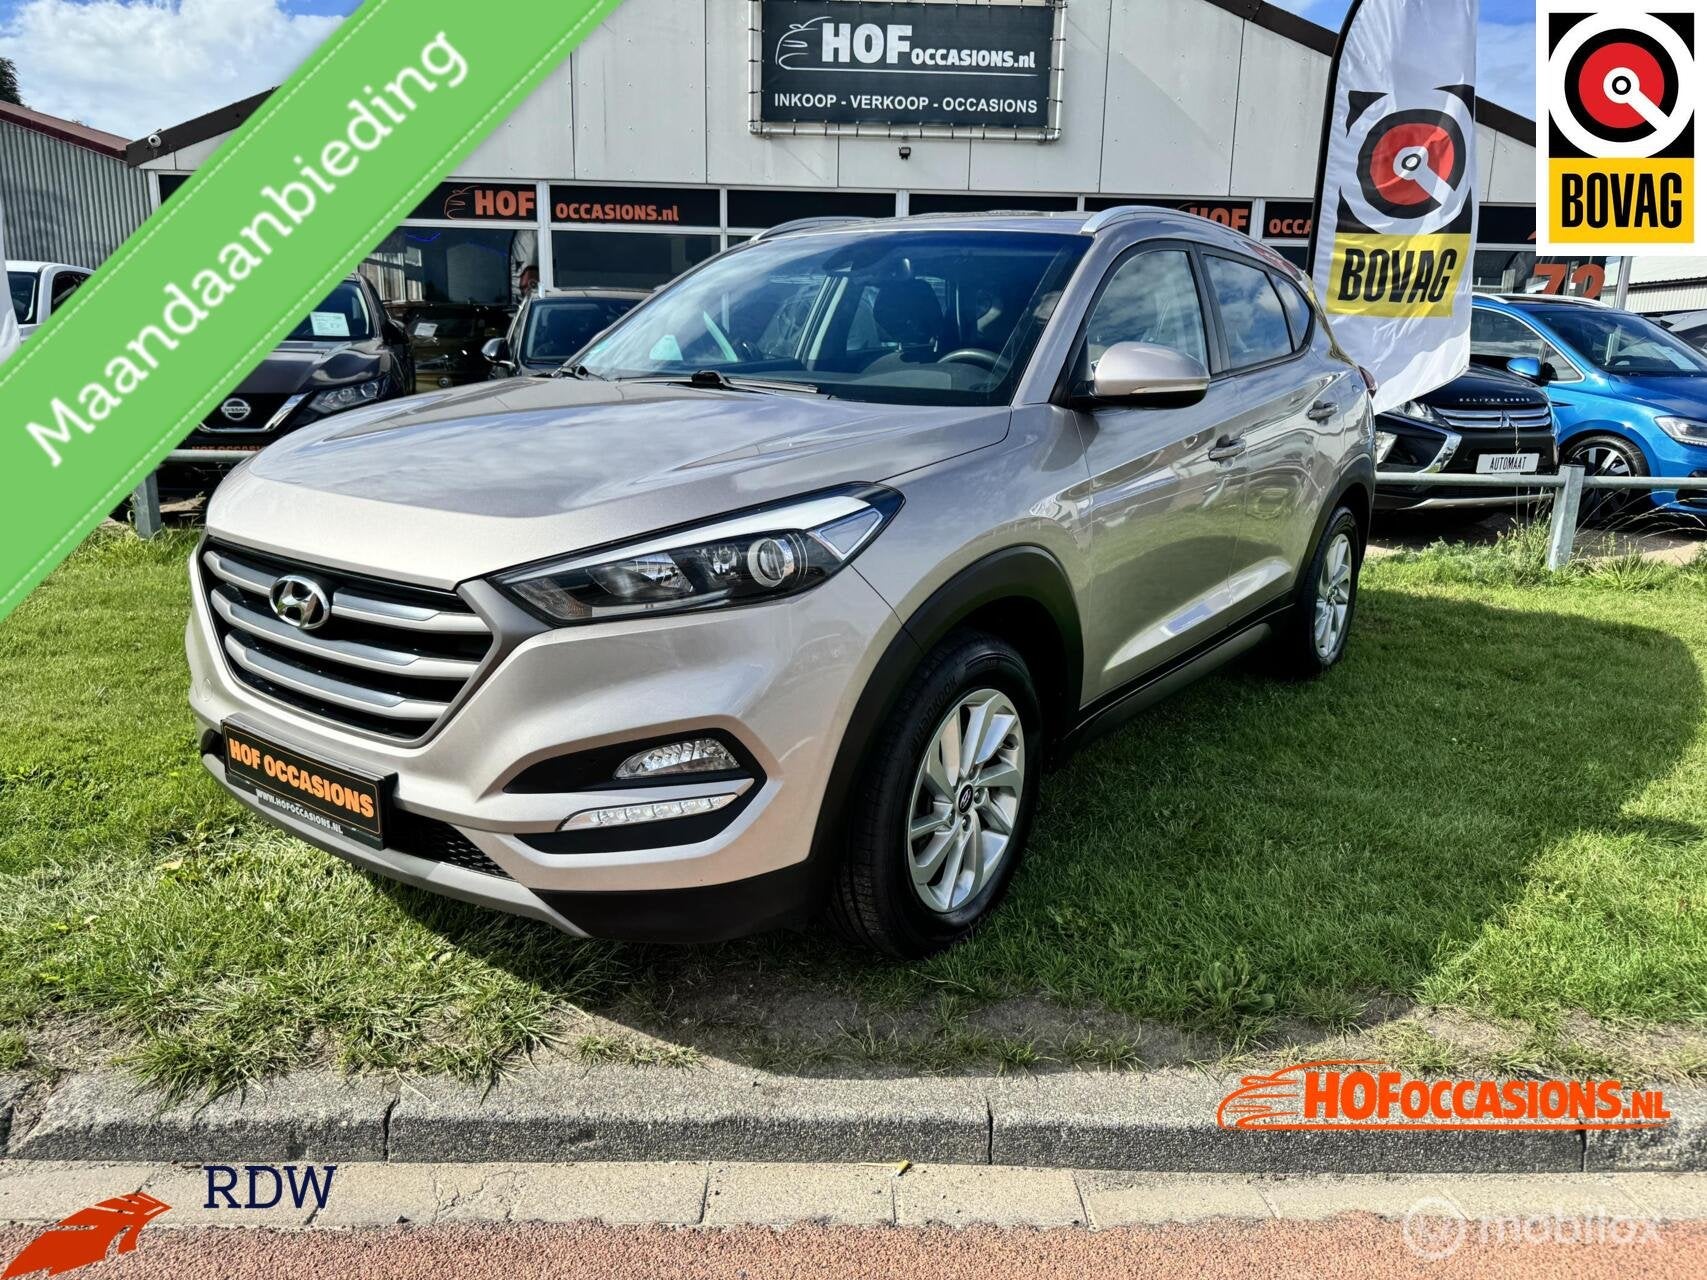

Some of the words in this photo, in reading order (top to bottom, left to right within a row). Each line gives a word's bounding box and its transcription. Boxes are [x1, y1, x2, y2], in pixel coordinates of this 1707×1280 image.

[774, 93, 837, 109] INKOOP
[850, 95, 929, 111] VERKOOP
[942, 97, 1038, 113] OCCASIONS
[474, 189, 536, 217] HOF
[555, 202, 680, 222] OCCASIONS.nl
[1337, 248, 1457, 304] BOVAG
[1489, 456, 1528, 471] AUTOMAAT
[228, 738, 261, 770] HOF
[263, 754, 376, 818] OCCASIONS
[255, 787, 344, 835] WWW.HOFOCCASIONS.NL
